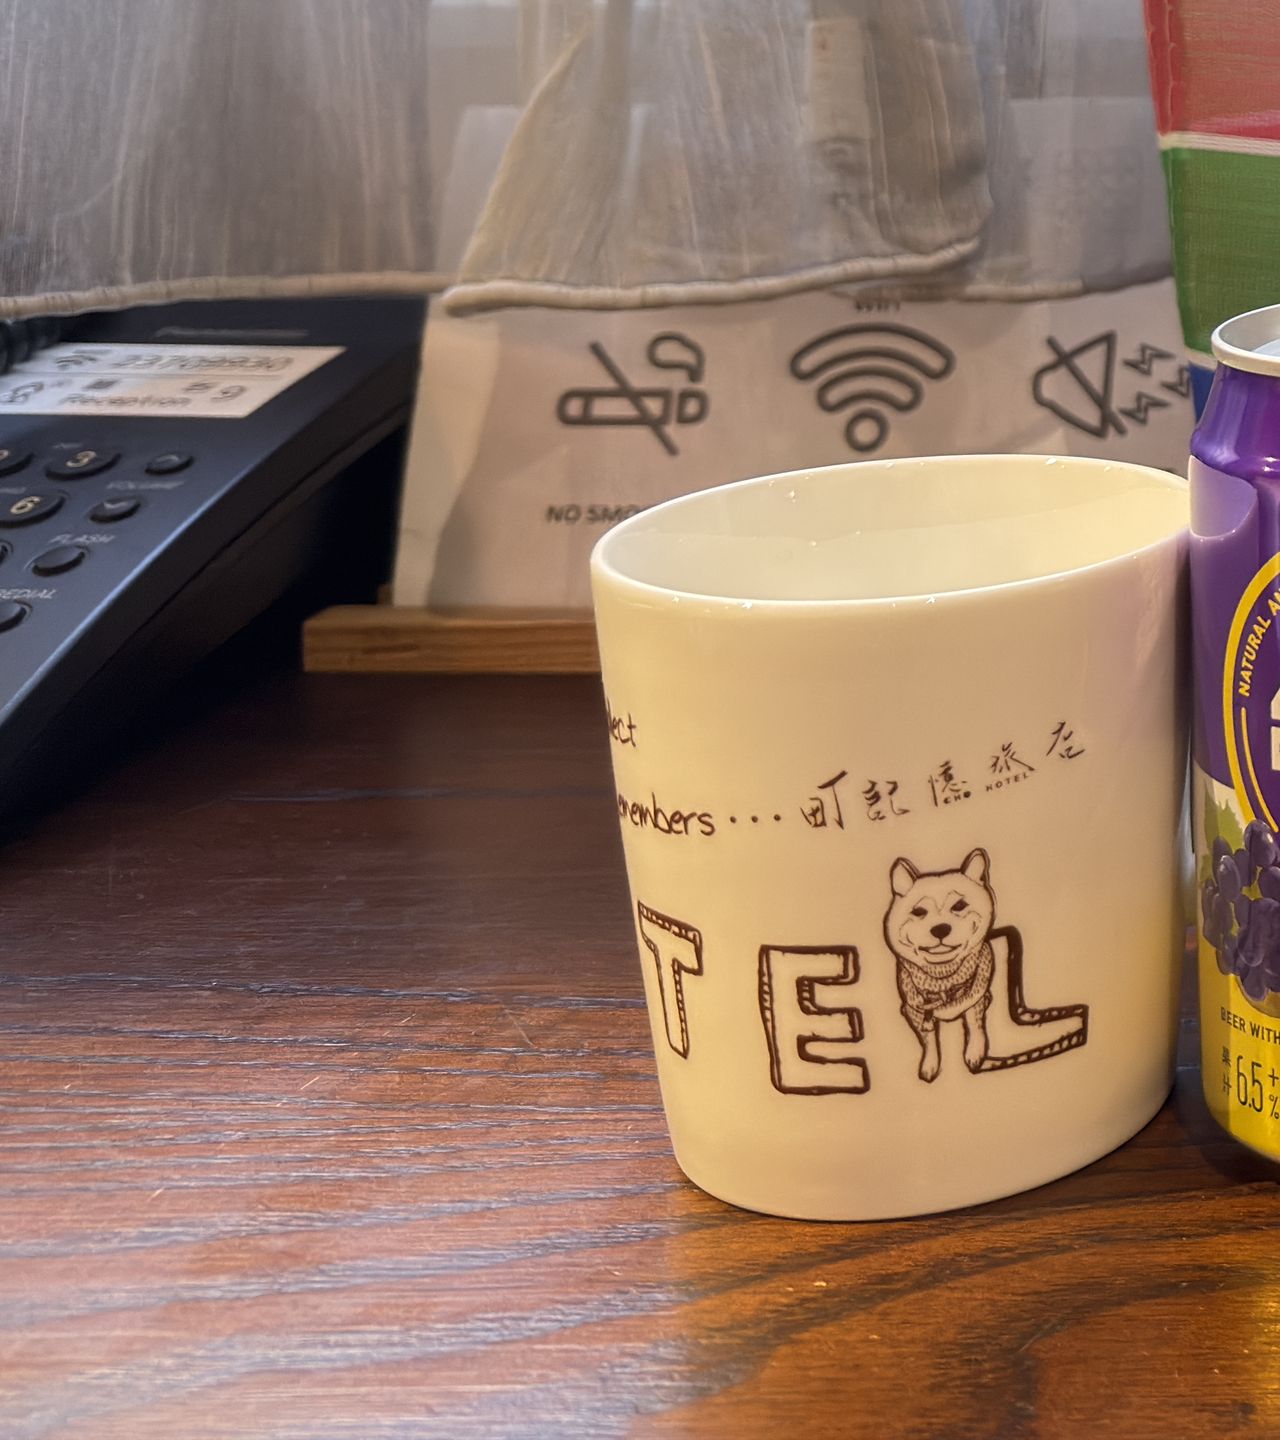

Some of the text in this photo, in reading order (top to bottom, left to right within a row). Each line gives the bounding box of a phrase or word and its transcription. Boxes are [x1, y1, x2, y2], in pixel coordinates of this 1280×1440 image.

[65, 450, 97, 468] 3
[10, 495, 42, 515] 6
[546, 504, 582, 525] NO
[1238, 616, 1272, 697] NATURAL
[985, 772, 1030, 793] HOTEL
[1220, 1006, 1247, 1033] BEER
[1236, 1055, 1264, 1113] 6.5
